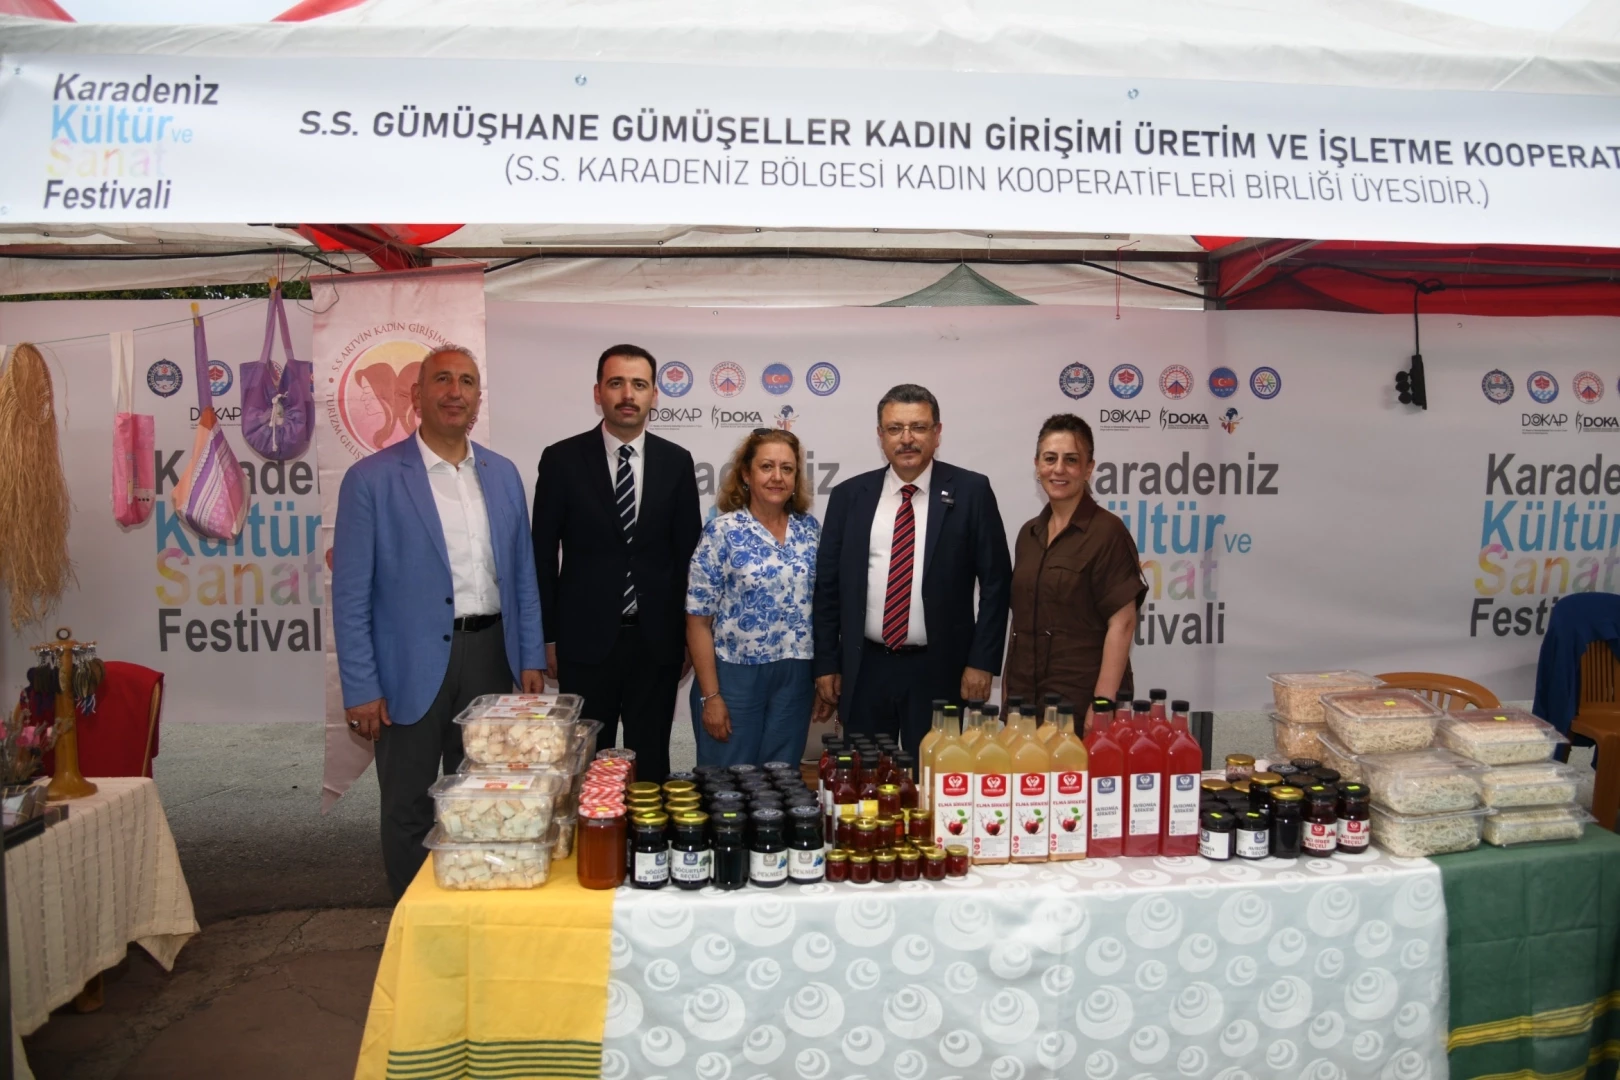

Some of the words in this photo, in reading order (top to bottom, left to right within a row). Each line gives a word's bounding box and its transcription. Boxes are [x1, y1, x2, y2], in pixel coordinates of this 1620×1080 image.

[53, 73, 219, 105] Karadeniz
[52, 104, 174, 144] Kültür
[171, 127, 193, 144] ve
[299, 110, 358, 136] S.S.
[373, 105, 599, 146] GÜMÜŞHANE
[612, 107, 851, 150] GÜMÜŞELLER
[866, 119, 971, 150] KADIN
[985, 116, 1122, 160] GİRİŞİMİ
[1135, 121, 1256, 159] ÜRETİM
[1267, 133, 1308, 161] VE
[1319, 128, 1453, 169] İŞLETME
[1464, 141, 1620, 169] KOOPERAT
[47, 137, 167, 177] Sanat
[43, 179, 172, 209] Festivali
[505, 153, 565, 185] (S.S.
[578, 156, 749, 186] KARADENİZ
[761, 156, 884, 188] BÖLGESİ
[896, 164, 986, 191] KADIN
[997, 167, 1235, 199] KOOPERATİFLERİ
[1245, 170, 1343, 201] BİRLİĞİ
[1351, 172, 1489, 209] ÜYESİDİR.)
[190, 407, 242, 421] DKAP
[720, 411, 763, 423] DOKA
[1100, 409, 1151, 423] DOKAP
[1168, 413, 1209, 424] DOKA
[1521, 413, 1568, 427] DOKAP
[1583, 416, 1619, 428] DOKA
[1087, 451, 1279, 496] aradeniz
[1224, 532, 1252, 554] ve
[155, 547, 323, 606] Sanat
